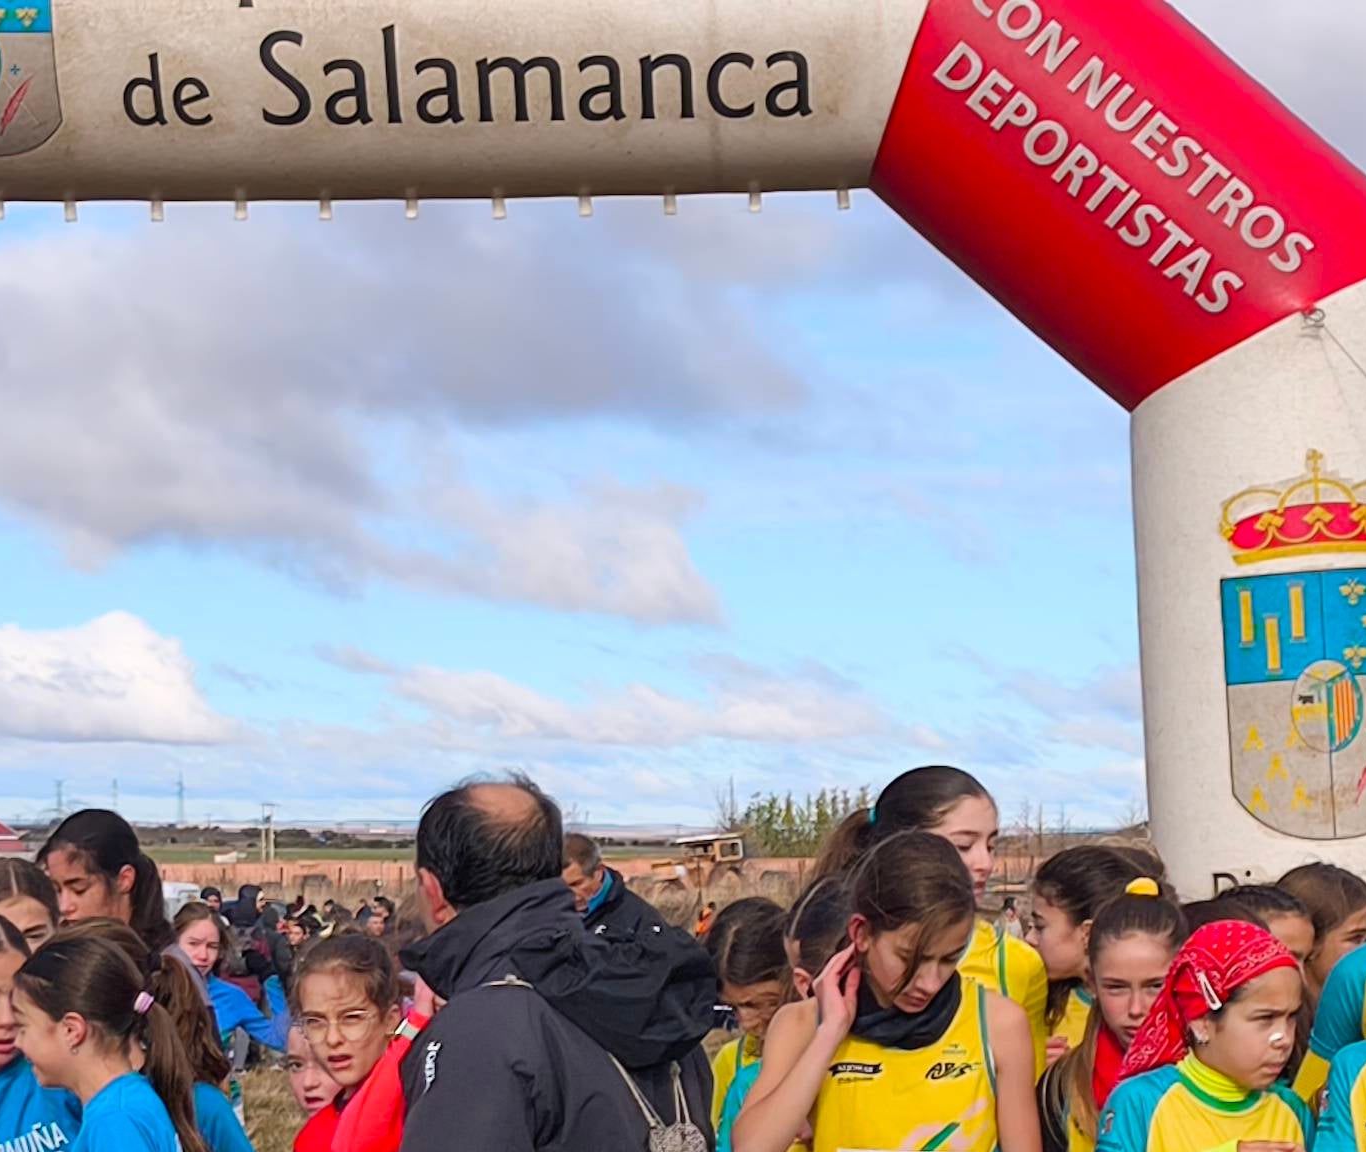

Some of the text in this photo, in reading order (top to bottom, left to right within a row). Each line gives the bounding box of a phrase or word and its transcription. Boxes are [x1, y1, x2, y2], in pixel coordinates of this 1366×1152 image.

[122, 24, 814, 127] de Salamanca
[933, 41, 1244, 314] DEPORTISTAS
[1067, 55, 1315, 273] NUESTROS
